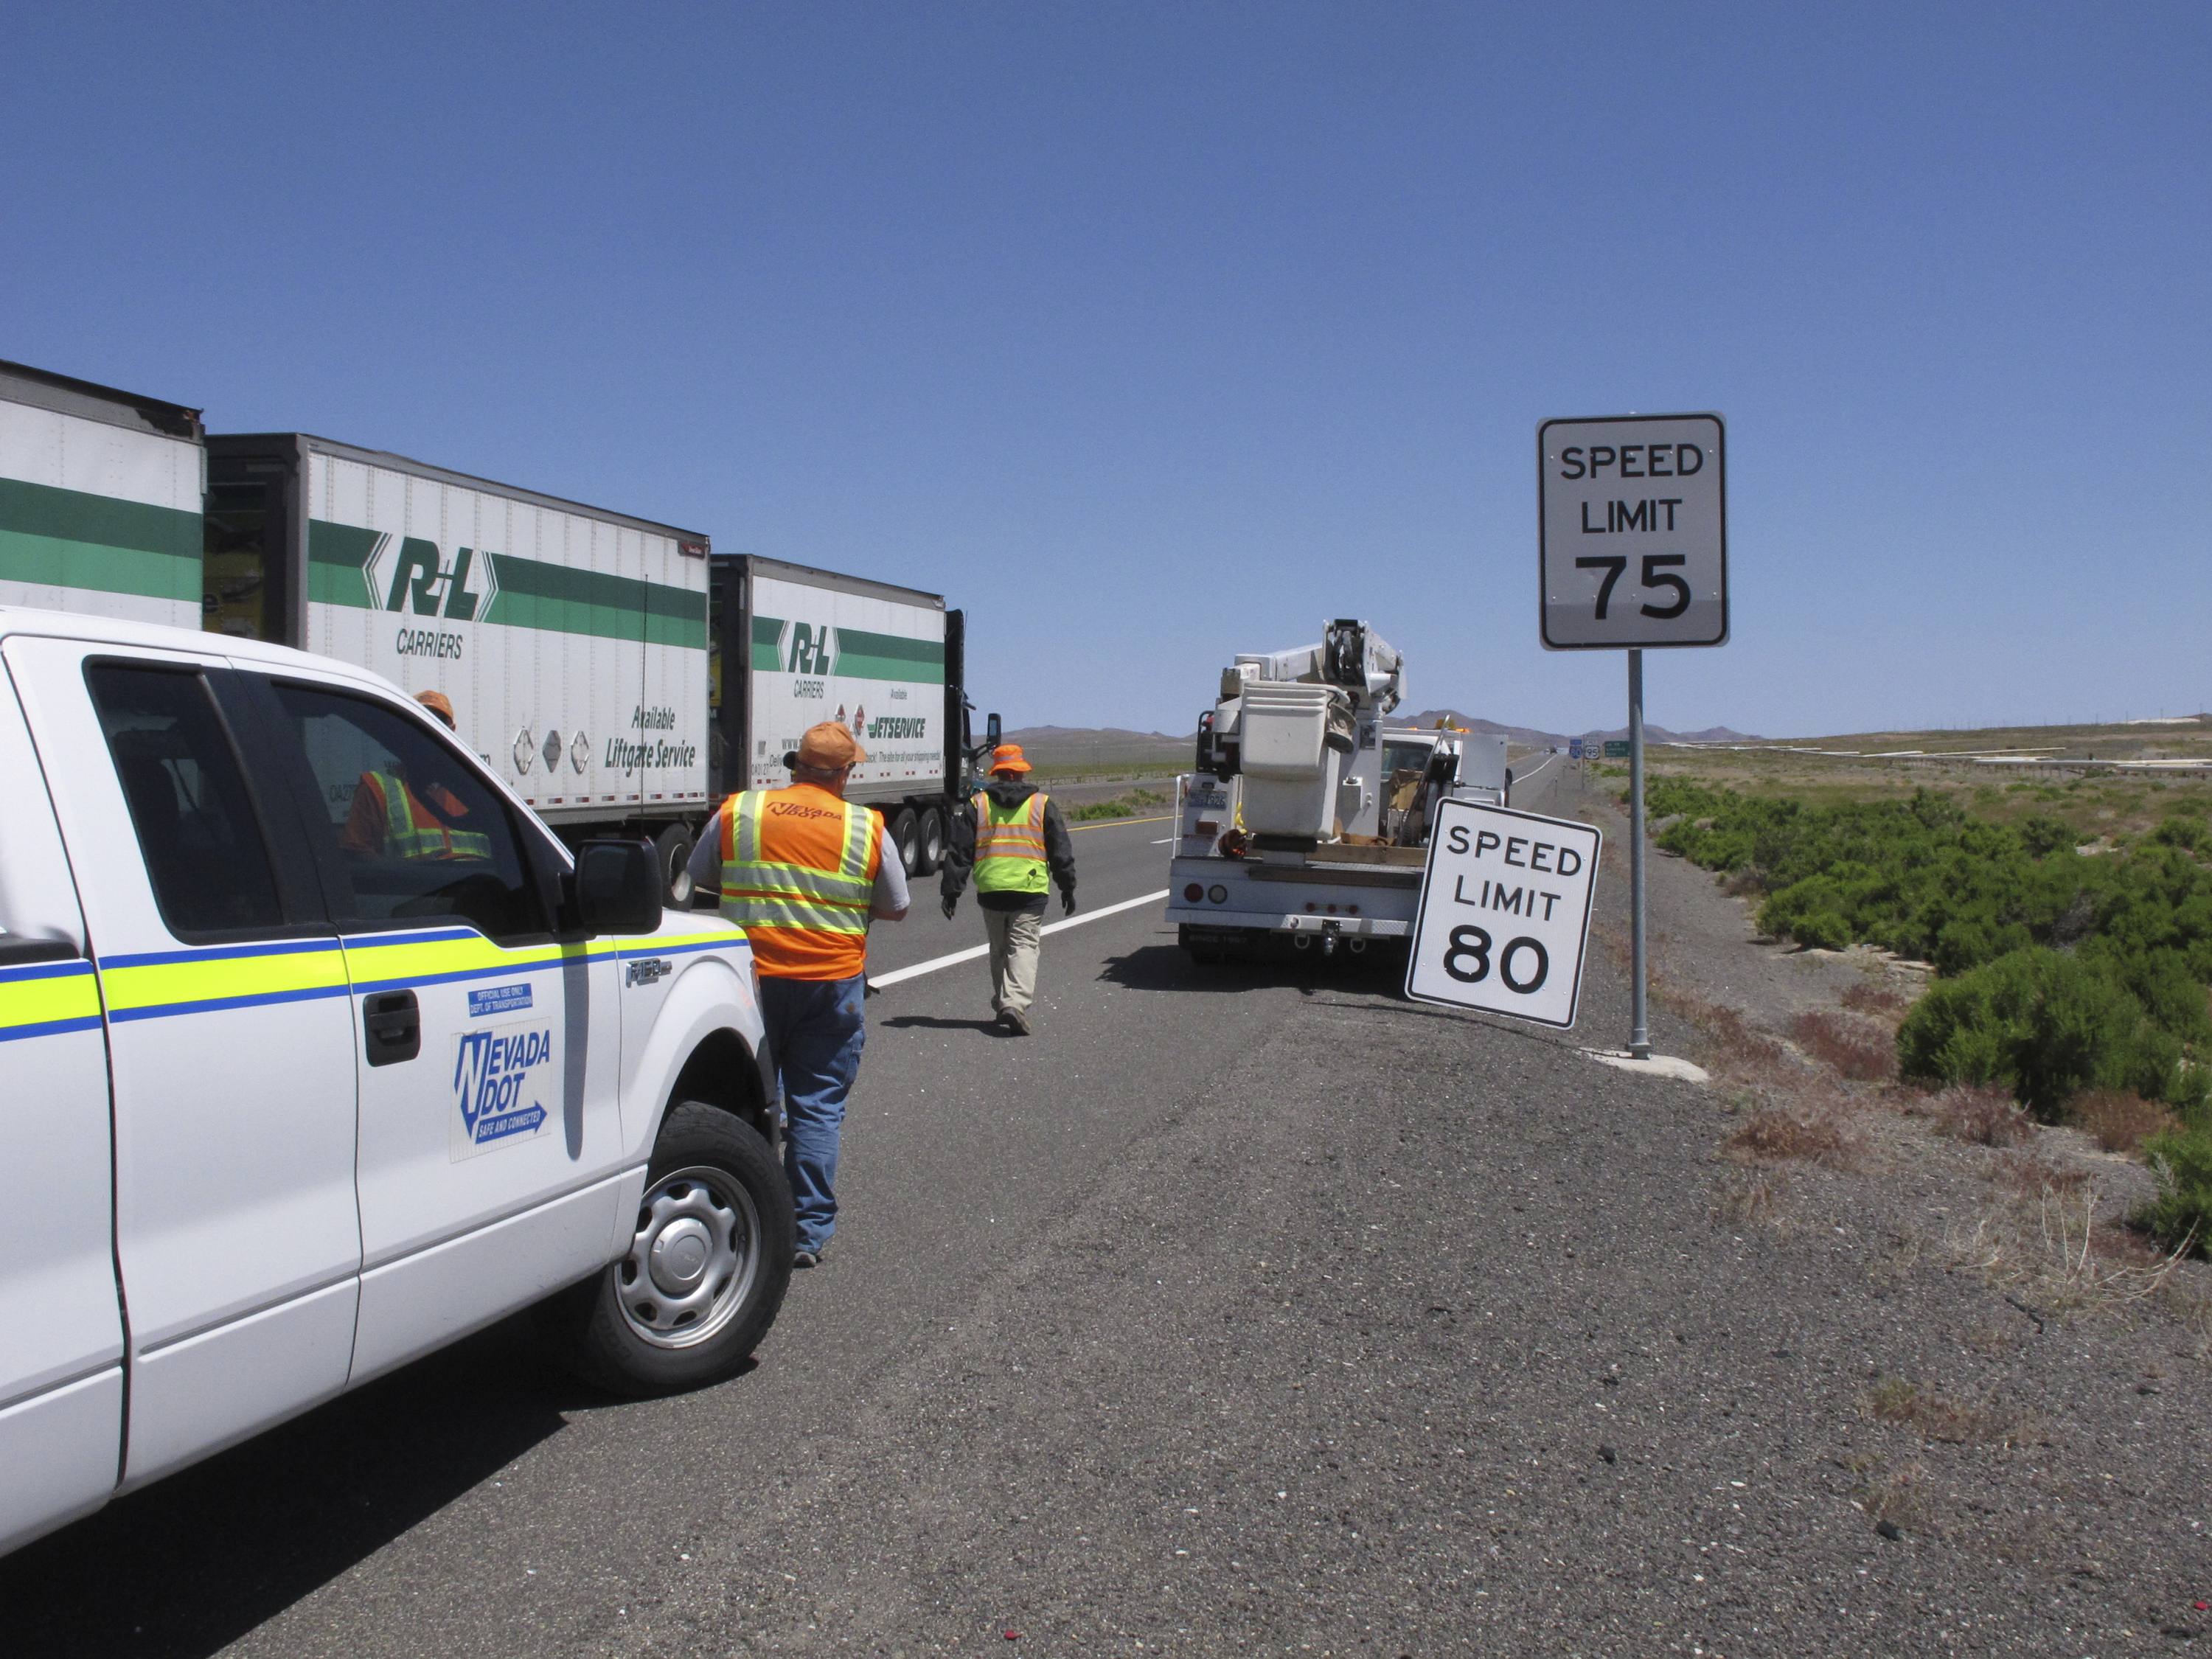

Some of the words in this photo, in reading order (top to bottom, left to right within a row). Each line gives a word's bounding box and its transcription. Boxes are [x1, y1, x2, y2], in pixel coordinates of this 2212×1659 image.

[1560, 443, 1704, 480] SPEED
[1582, 498, 1683, 533] LIMIT
[1575, 554, 1691, 620] 75
[396, 627, 464, 660] CARRIERS
[793, 679, 824, 699] CARRIERS
[631, 705, 675, 730] Available
[867, 717, 926, 738] JETSERVICE
[605, 737, 654, 778] Liftgate
[655, 739, 695, 768] Service
[1587, 748, 1598, 757] 95
[766, 801, 842, 821] NEVADA
[786, 810, 821, 820] DOT
[1446, 825, 1582, 877] SPEED
[1454, 874, 1562, 922] LIMIT
[1443, 924, 1549, 995] 80
[477, 990, 500, 1001] OFFICIAL
[500, 987, 511, 998] USE
[511, 986, 524, 996] ONLY
[484, 1002, 492, 1012] OF
[492, 996, 532, 1010] TRANSPORTATION
[480, 1072, 526, 1116] DOT
[479, 1121, 495, 1138] SAFE
[495, 1117, 507, 1134] AND
[507, 1110, 541, 1130] CONNECTED
